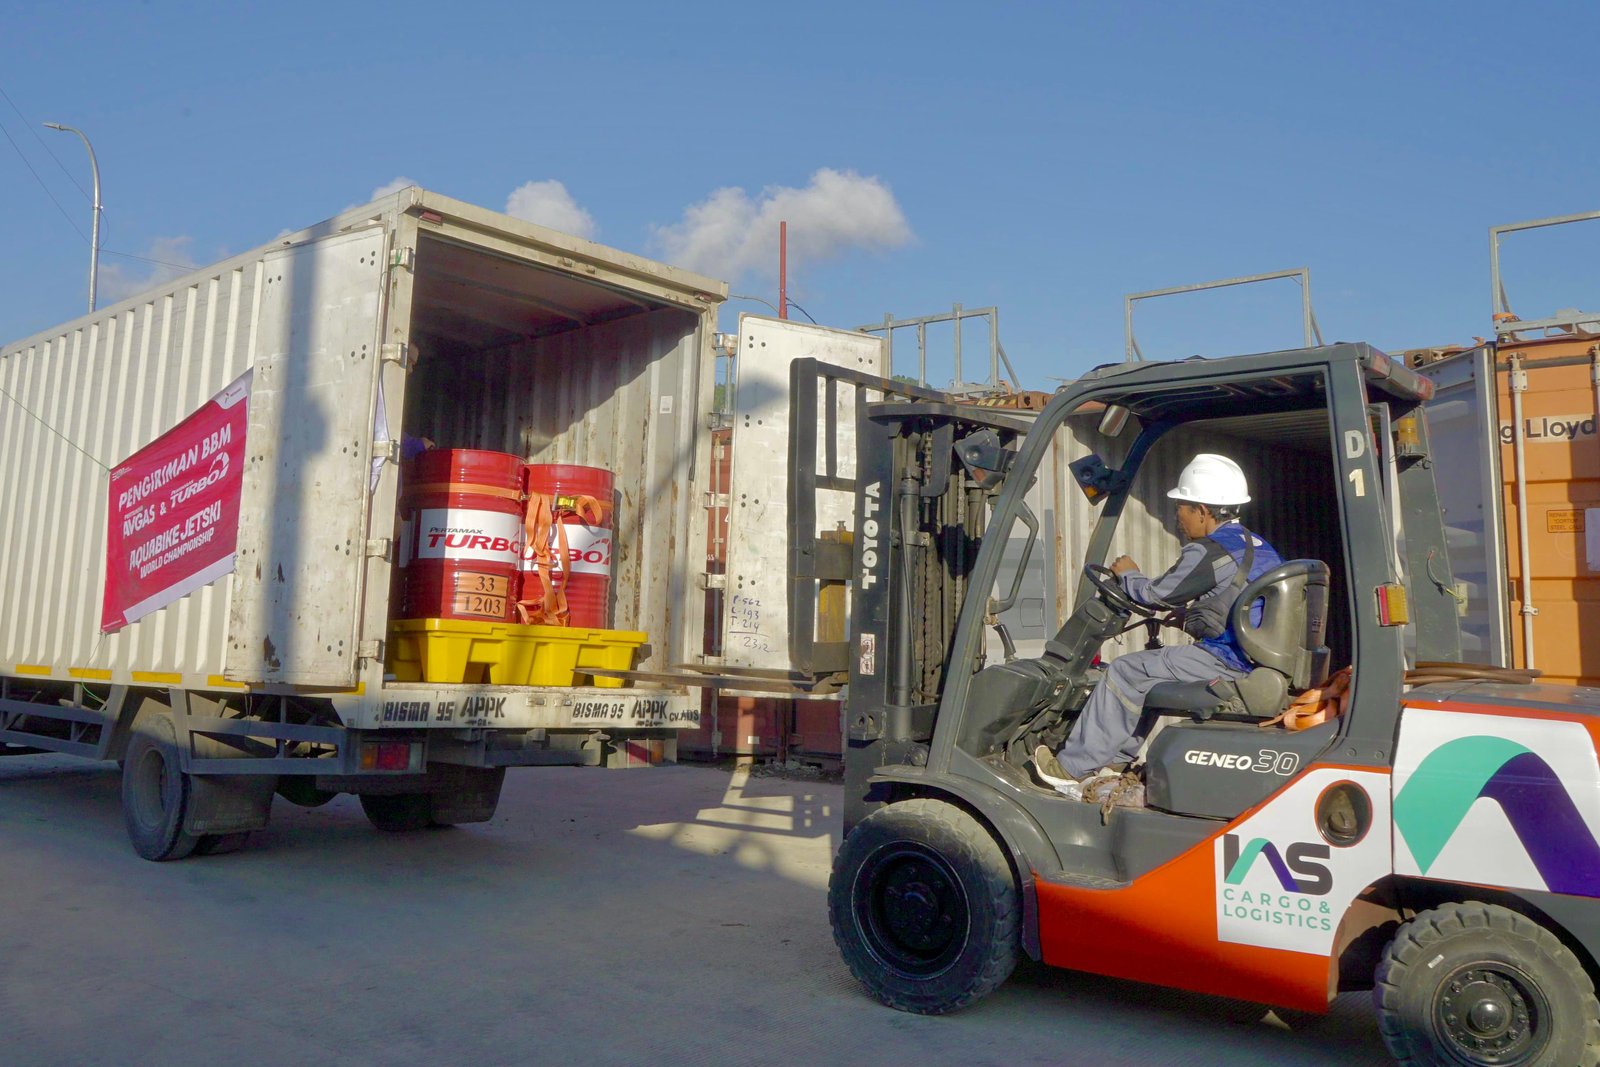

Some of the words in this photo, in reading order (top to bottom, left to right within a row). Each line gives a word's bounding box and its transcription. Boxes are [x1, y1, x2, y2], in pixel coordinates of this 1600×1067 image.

[1344, 430, 1365, 459] D
[119, 445, 199, 512] PENGIRIMAN
[201, 423, 231, 461] BBM
[170, 468, 220, 509] TURBO
[1348, 469, 1365, 497] 1
[122, 503, 155, 539] AVGAS
[160, 501, 167, 516] &
[429, 526, 483, 535] PERTAMAX
[129, 524, 180, 571] AQUABIKE
[180, 500, 221, 541] JETSKI
[861, 481, 881, 590] TOYOTA
[140, 554, 163, 579] WORLD
[163, 527, 215, 566] CHAMPIONSHIP
[475, 575, 495, 592] 33
[463, 597, 501, 614] 1203
[384, 702, 430, 722] BISMA
[435, 702, 455, 721] 95
[459, 696, 507, 718] APPK
[572, 702, 609, 719] BISMA
[610, 703, 625, 719] 95
[631, 699, 668, 719] APPK
[1184, 750, 1252, 770] GENEO
[1252, 749, 1300, 776] 30
[1223, 888, 1311, 912] CARGO
[1319, 901, 1331, 915] &
[1223, 904, 1331, 932] LOGISTICS
